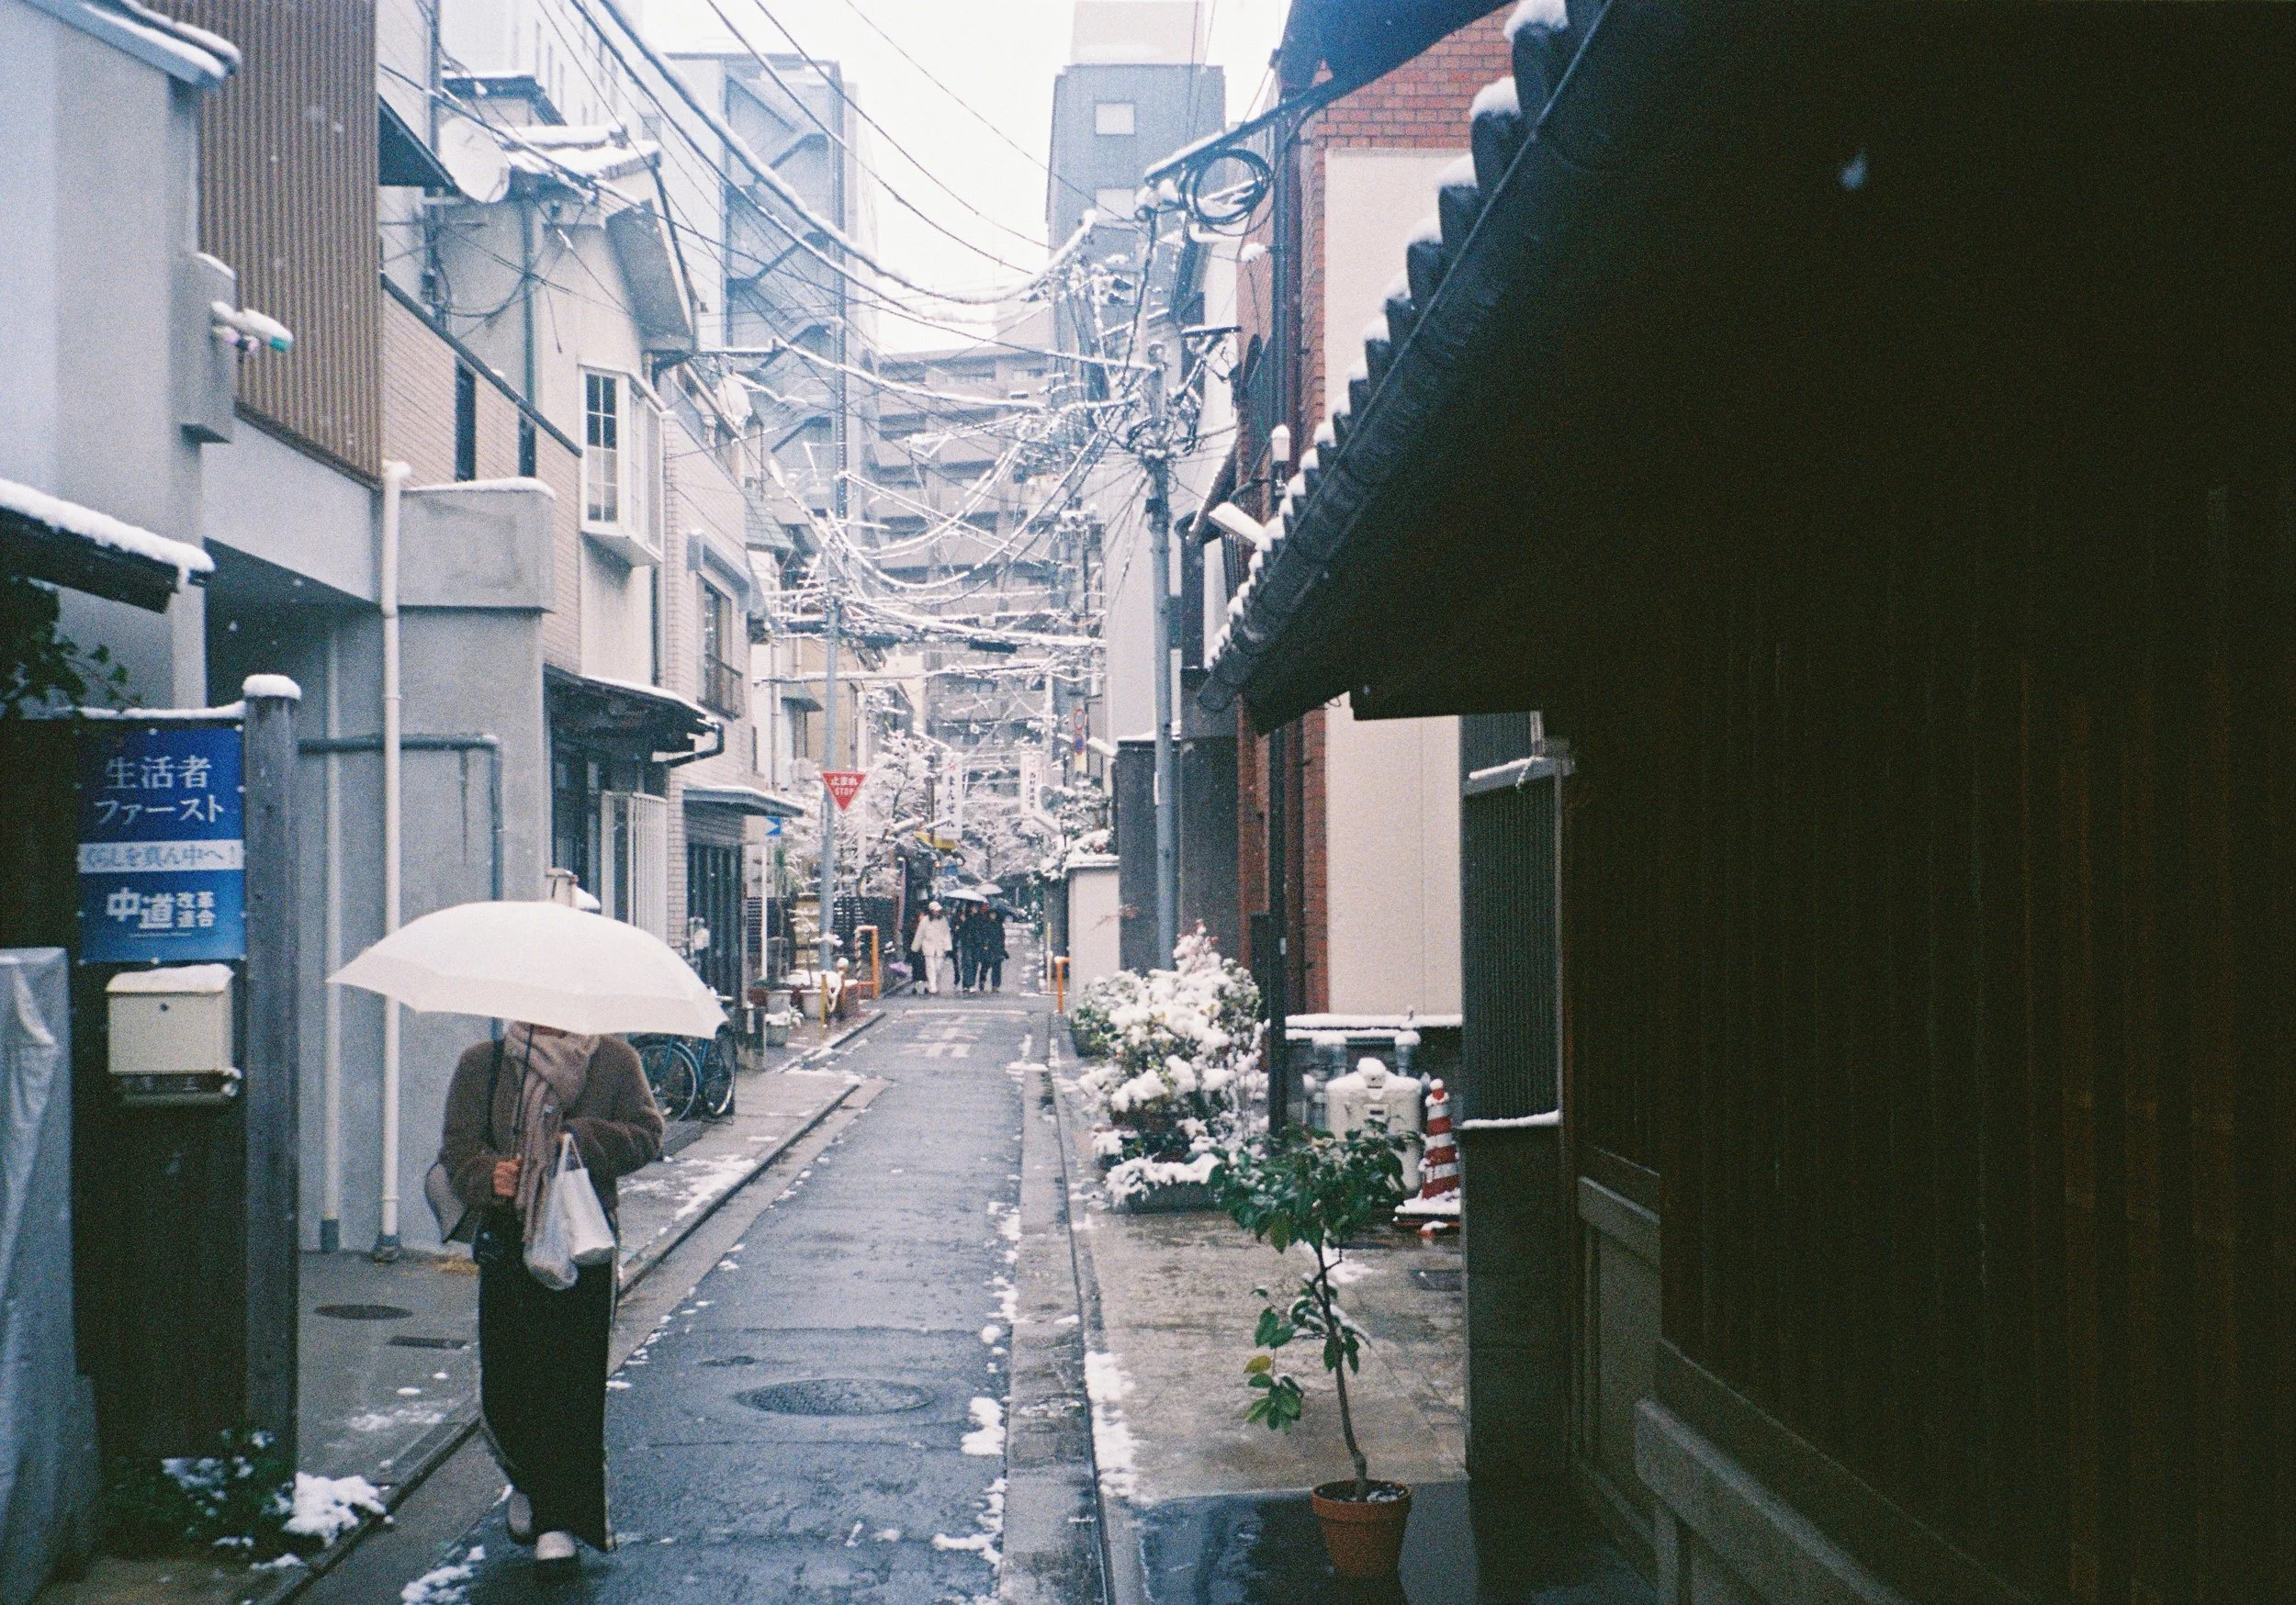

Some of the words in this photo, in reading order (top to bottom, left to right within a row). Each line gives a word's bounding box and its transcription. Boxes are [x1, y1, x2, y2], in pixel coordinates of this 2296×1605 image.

[106, 754, 212, 789] 生活者
[834, 787, 854, 796] STOP
[94, 794, 224, 825] ファースト
[106, 887, 175, 929] 中道
